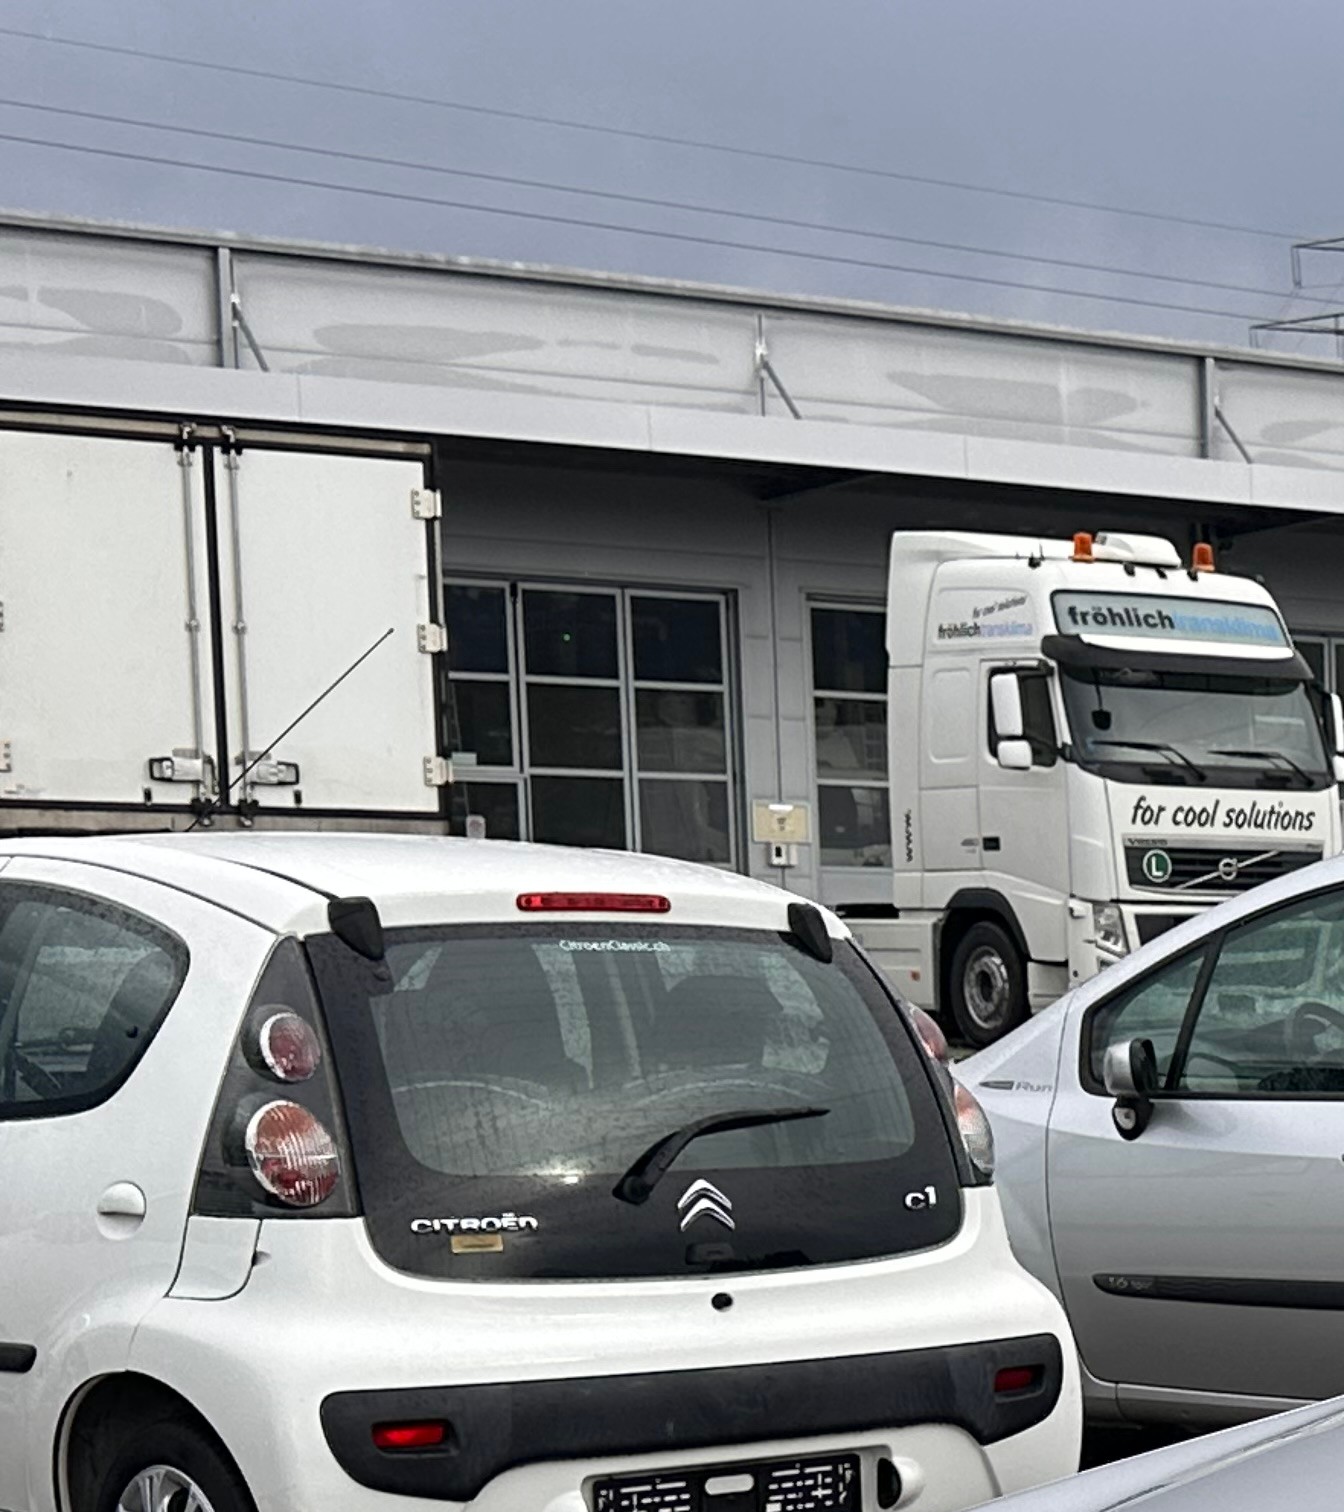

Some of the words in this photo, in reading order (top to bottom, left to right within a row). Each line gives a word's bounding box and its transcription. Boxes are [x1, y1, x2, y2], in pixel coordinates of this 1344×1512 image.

[1131, 795, 1166, 826] for
[1171, 799, 1220, 828] cool
[1222, 801, 1316, 832] solutions
[411, 1212, 539, 1234] CITROËN
